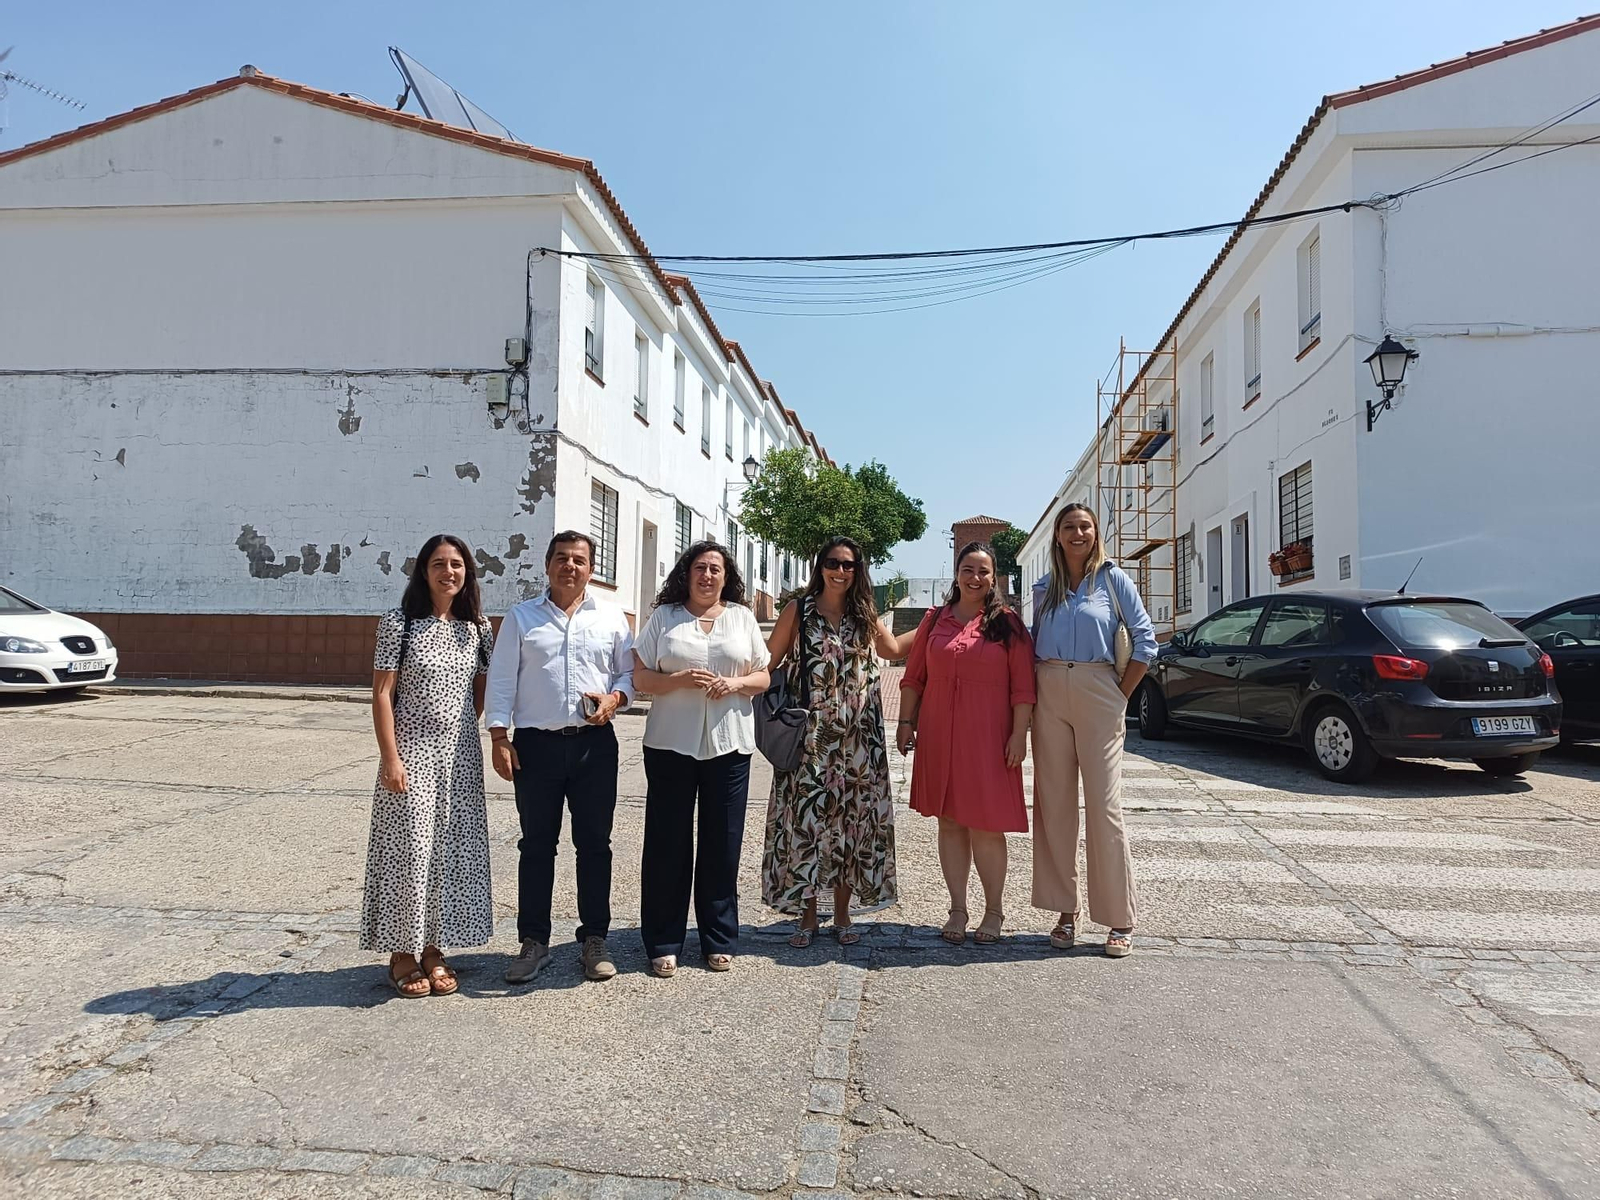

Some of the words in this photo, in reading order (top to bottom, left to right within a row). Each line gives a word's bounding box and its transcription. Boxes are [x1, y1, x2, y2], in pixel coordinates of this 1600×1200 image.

[73, 661, 91, 670] 4187
[1479, 718, 1509, 731] 9199
[1511, 717, 1531, 730] GZY
